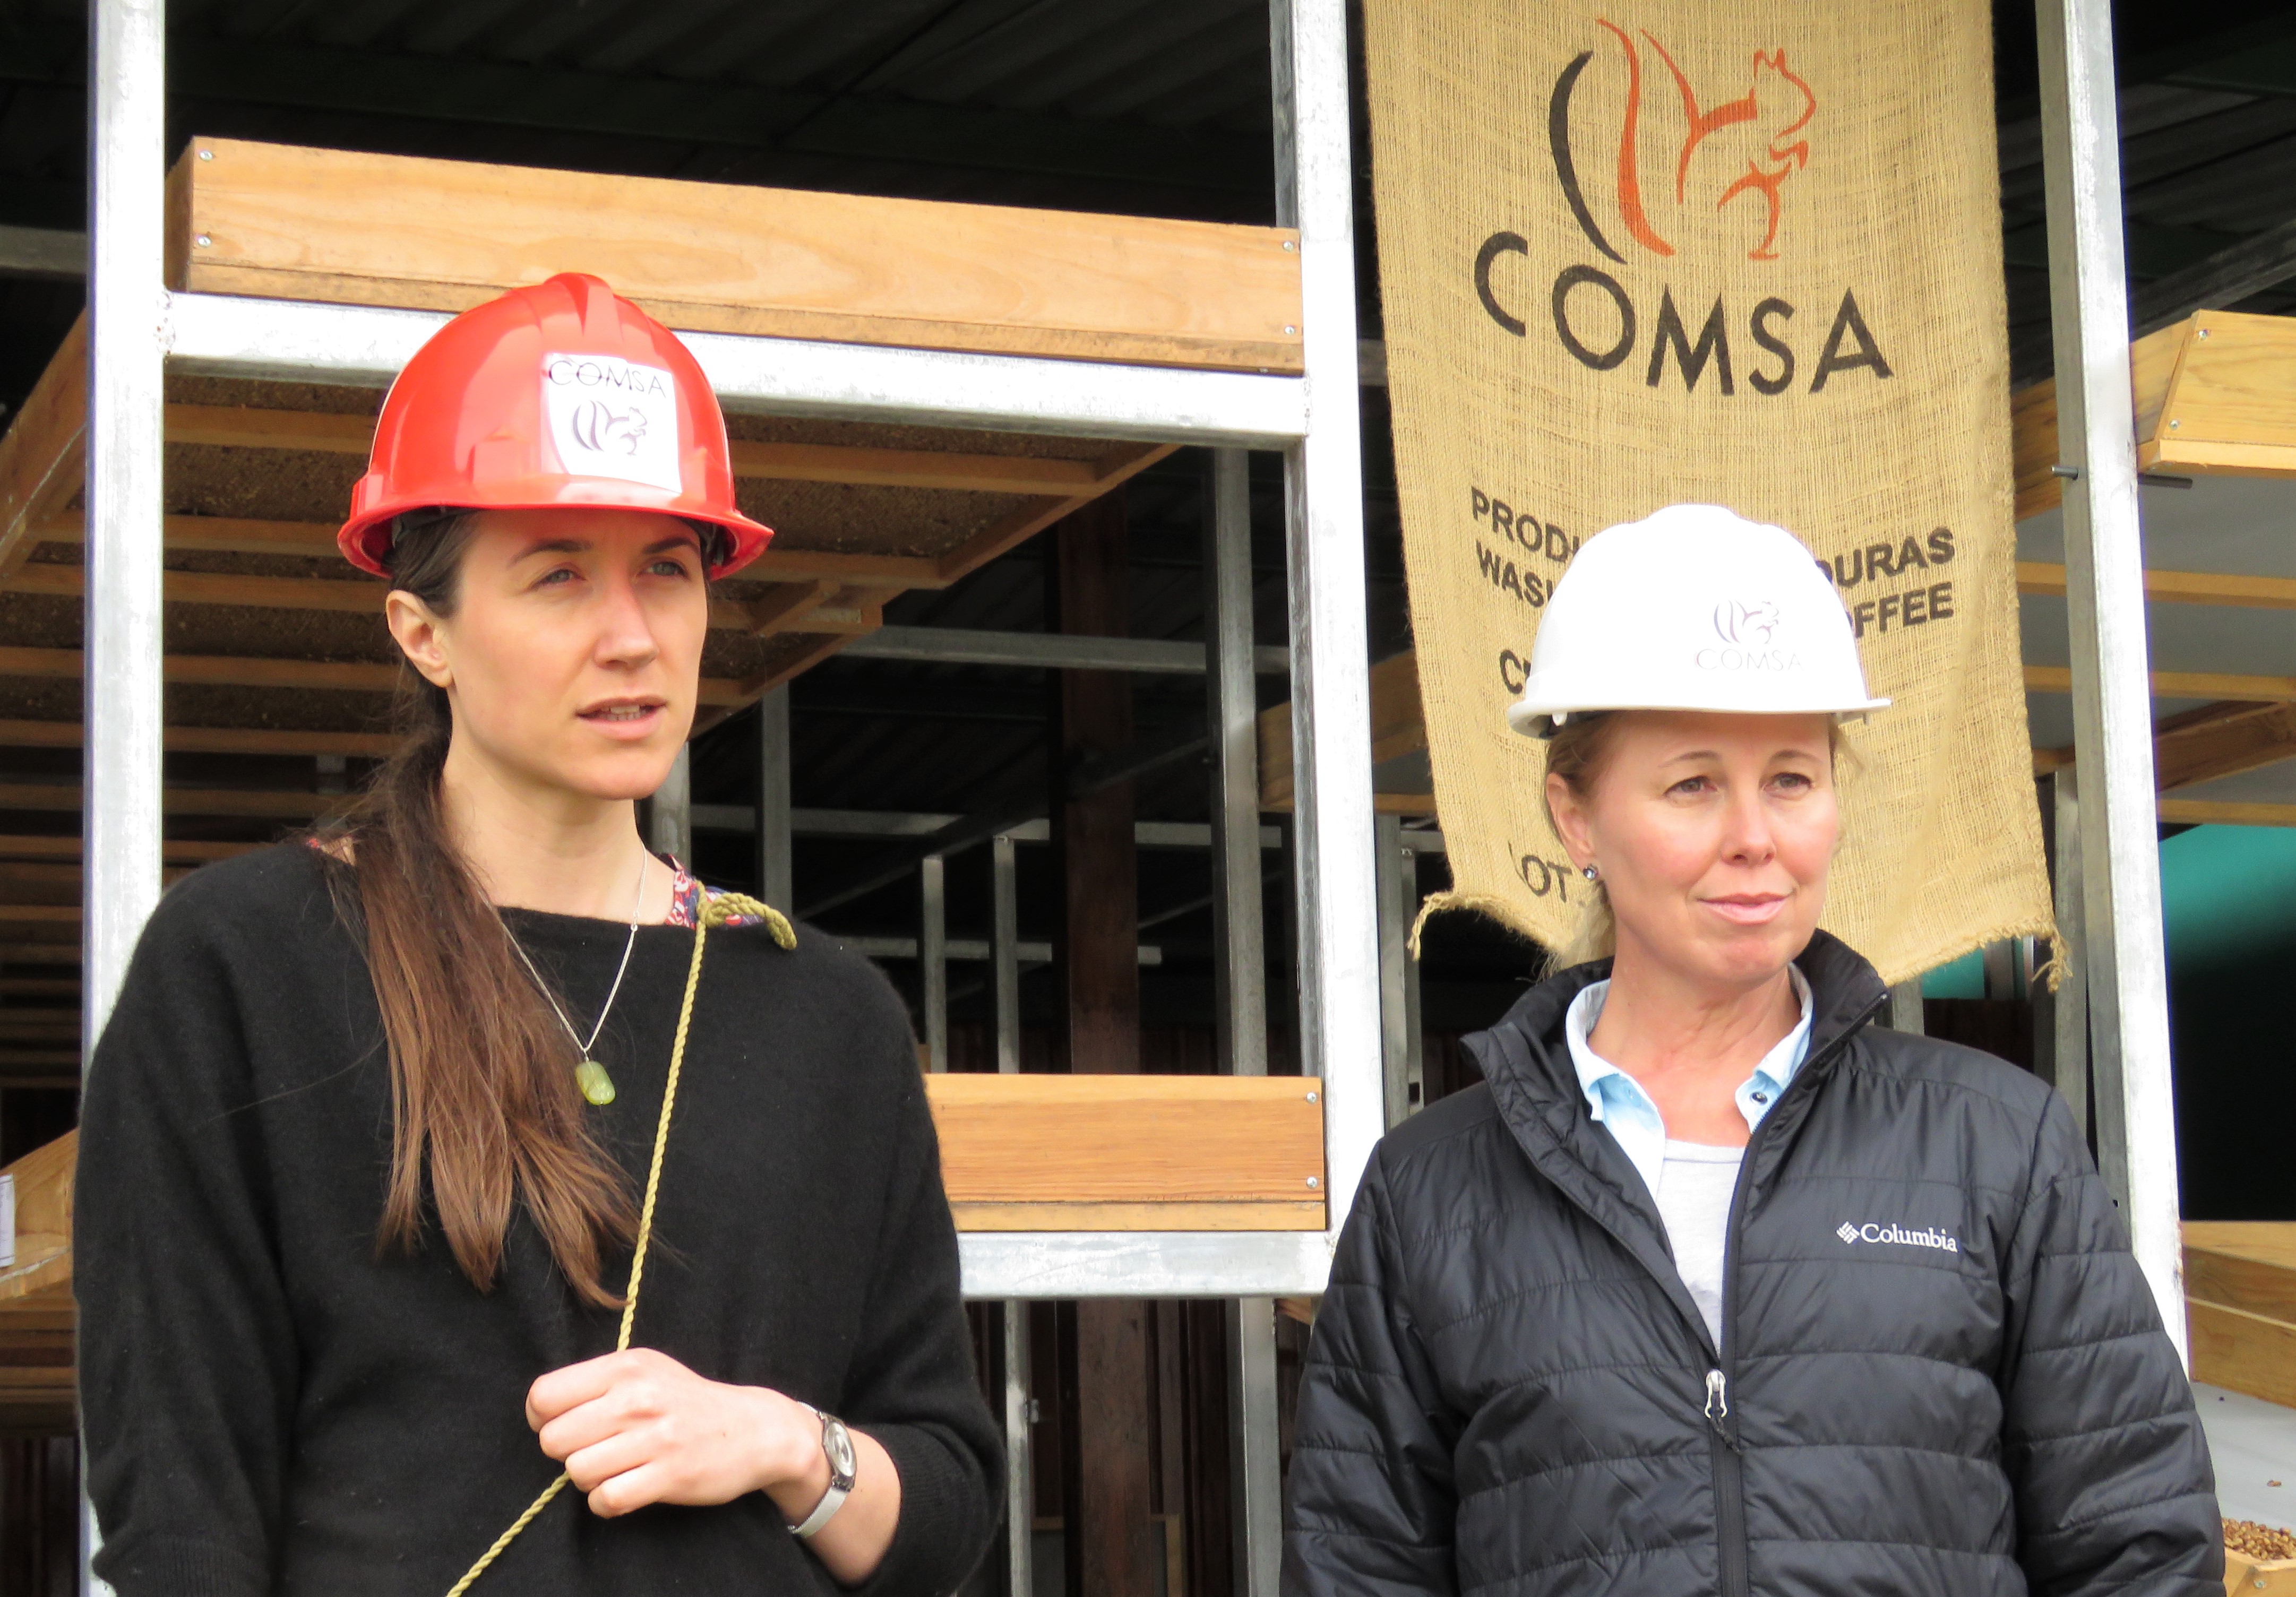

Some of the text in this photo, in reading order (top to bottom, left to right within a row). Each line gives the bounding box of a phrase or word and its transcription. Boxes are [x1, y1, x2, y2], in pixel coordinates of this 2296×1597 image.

[1474, 230, 1893, 395] COMSA
[548, 360, 666, 399] COMSA
[1846, 581, 1954, 638] FFEE
[1696, 648, 1804, 671] COMSA
[1860, 1222, 1958, 1253] Columbia
